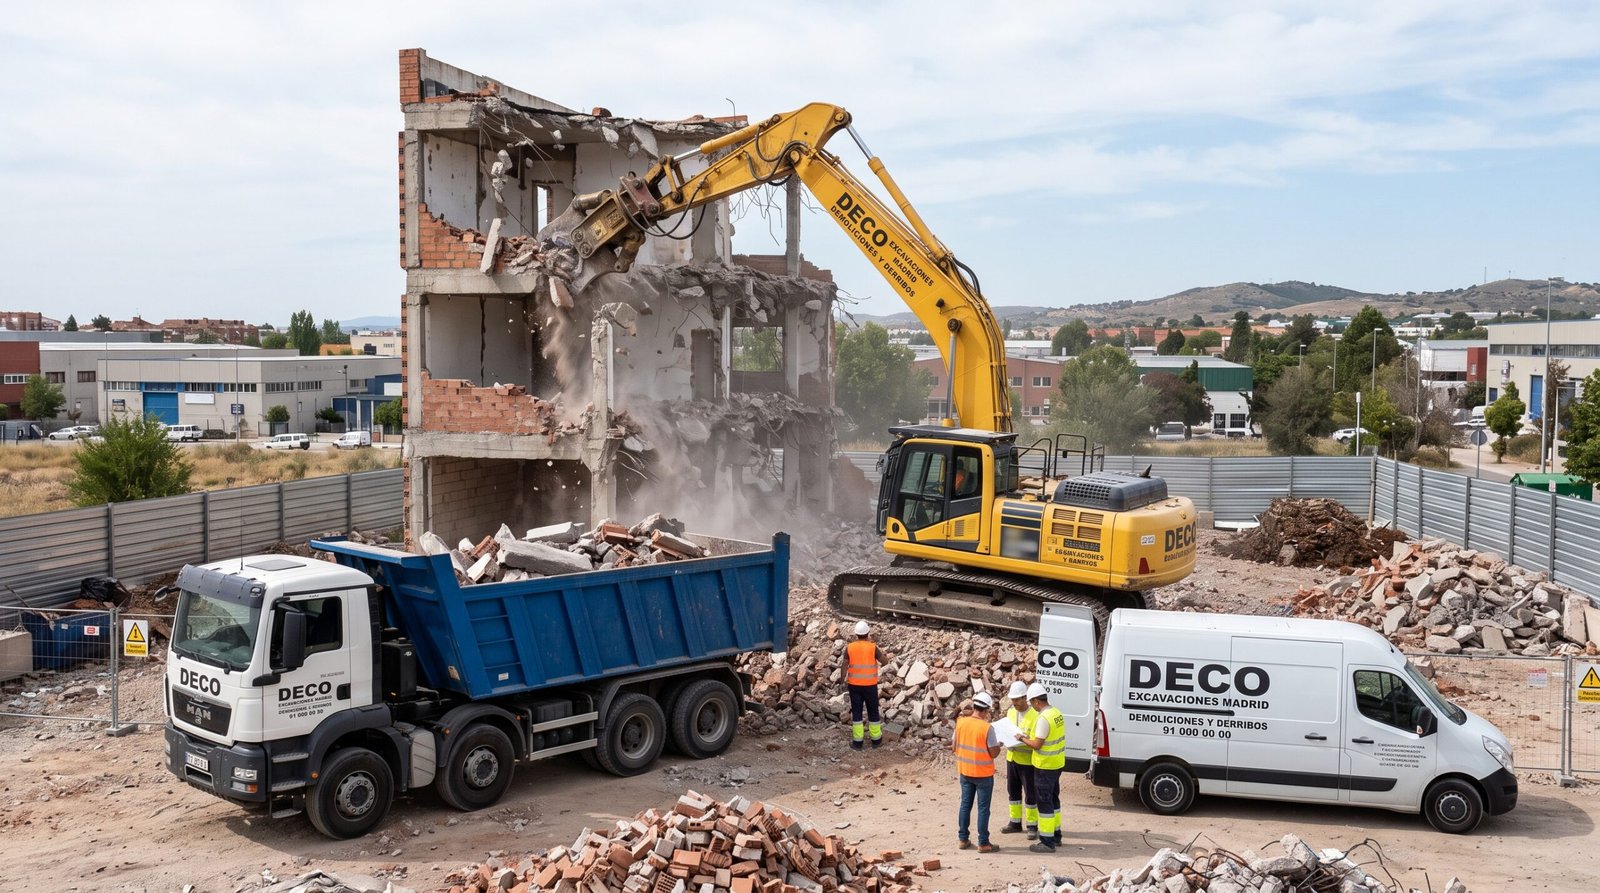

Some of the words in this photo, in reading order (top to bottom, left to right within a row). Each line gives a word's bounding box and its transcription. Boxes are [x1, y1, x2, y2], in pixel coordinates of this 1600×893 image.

[836, 192, 888, 247] DECO
[830, 206, 878, 257] DEMOLICIONES
[884, 263, 915, 298] DERRIBOS
[889, 241, 934, 287] EXCAVACIONES
[893, 257, 917, 283] MADRID
[1165, 521, 1196, 552] DECO
[1038, 649, 1079, 670] CO
[180, 667, 221, 696] DECO
[1049, 680, 1078, 688] DERRIBOS
[1052, 671, 1079, 679] MADRID
[1129, 659, 1270, 697] DECO
[279, 681, 331, 701] DECO
[1128, 692, 1219, 706] EXCAVACIONES
[1222, 698, 1269, 709] MADRID
[186, 703, 211, 720] MAN
[1129, 713, 1204, 726] DEMOLICIONES
[1207, 719, 1214, 727] Y
[1216, 719, 1268, 731] DERRIBOS
[1163, 726, 1176, 735] 91
[1179, 727, 1199, 737] 000
[1202, 729, 1215, 738] 00
[1218, 730, 1231, 739] 00
